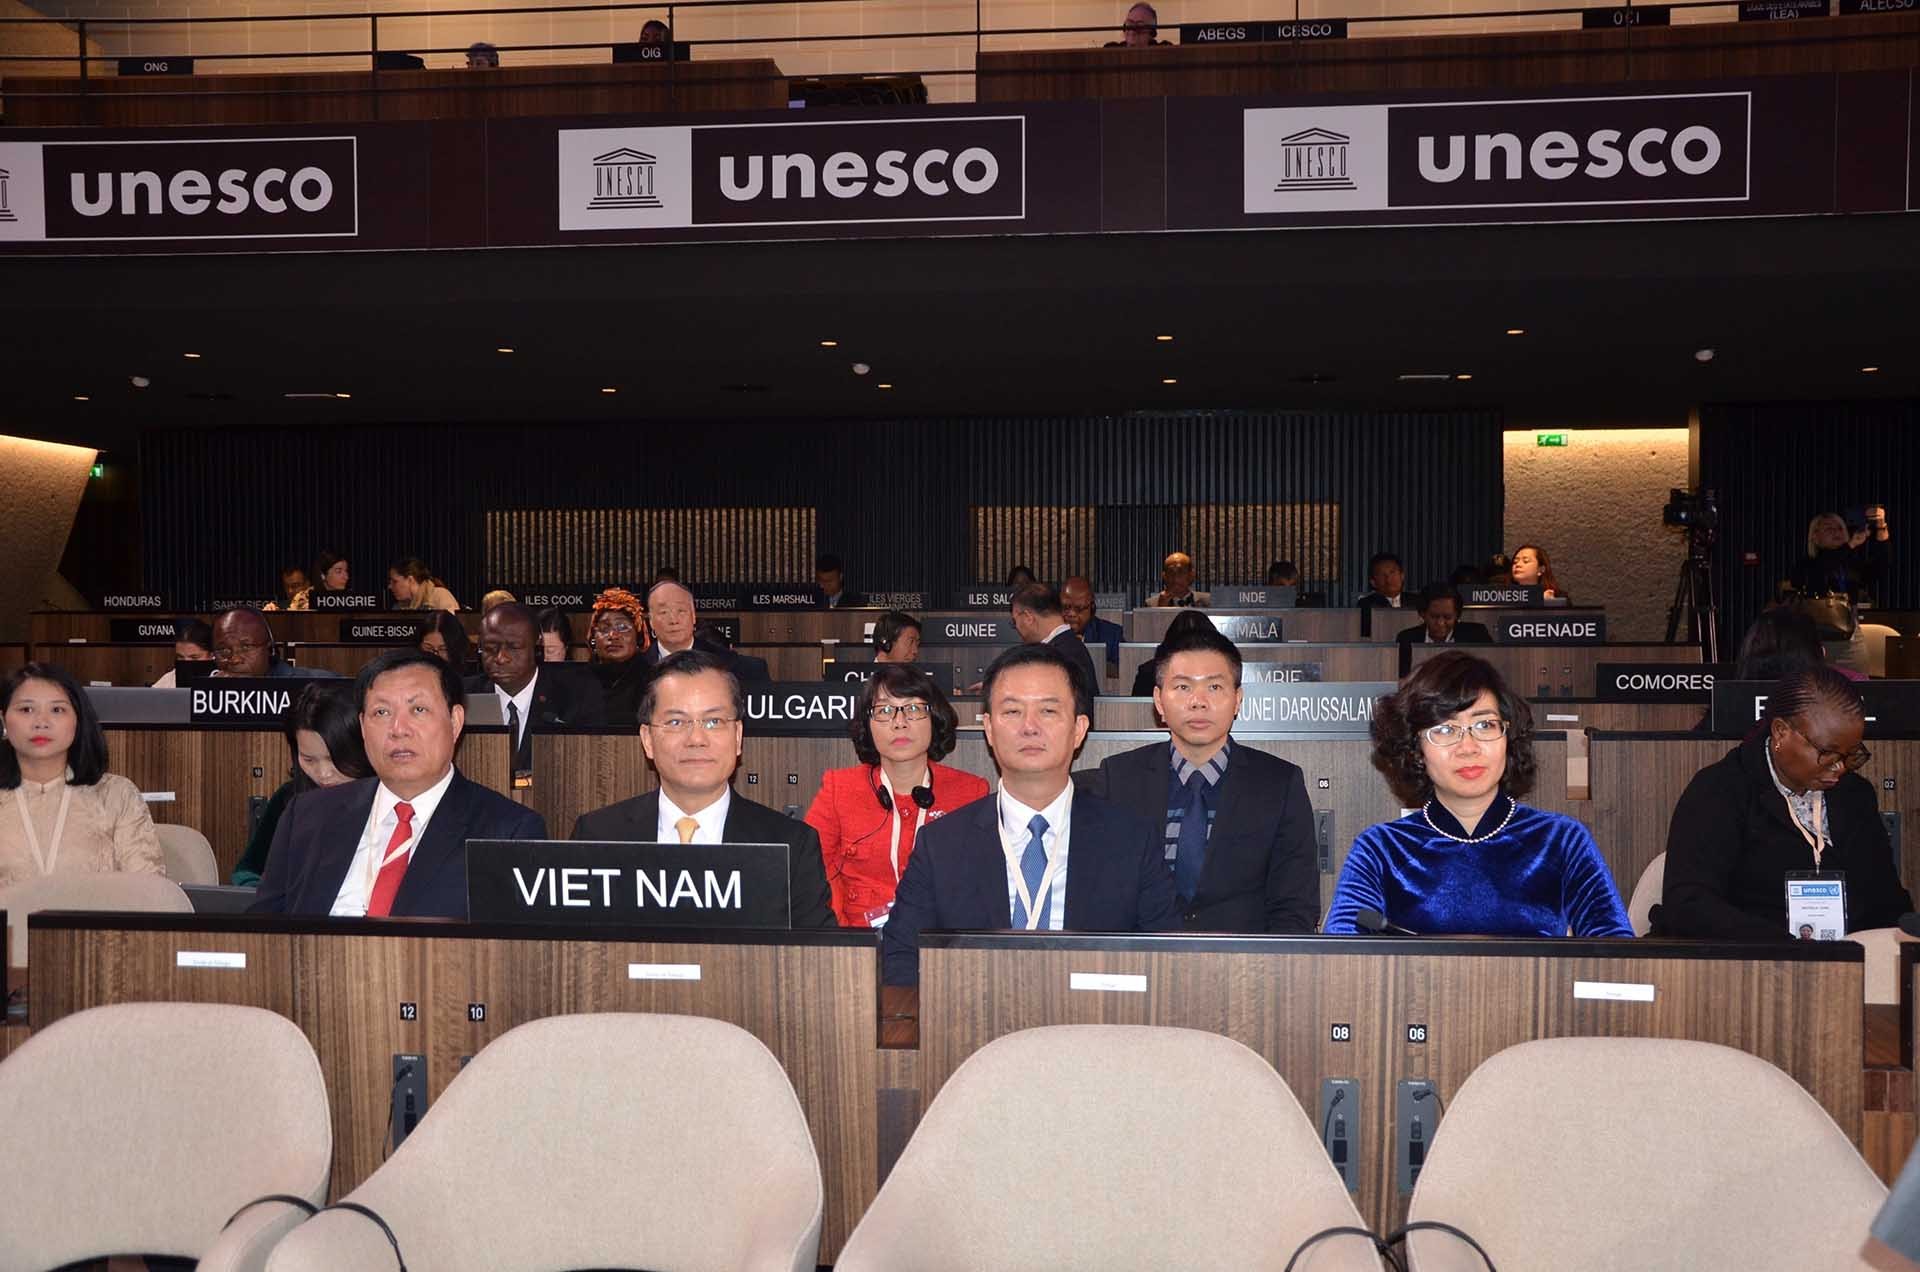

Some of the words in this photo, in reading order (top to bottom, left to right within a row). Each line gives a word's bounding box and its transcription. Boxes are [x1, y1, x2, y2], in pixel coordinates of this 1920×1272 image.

[1197, 27, 1247, 41] ABEGS
[1277, 24, 1332, 38] ICESCO
[641, 47, 661, 59] OIG
[143, 61, 168, 73] ONG
[1418, 125, 1722, 184] unesco
[1285, 146, 1346, 178] UNESCO
[719, 146, 1000, 201] unesco
[596, 165, 654, 197] UNESCO
[70, 166, 334, 217] unesco
[103, 595, 161, 607] HONDURAS
[316, 595, 376, 607] HONGRIE
[524, 595, 549, 606] ILES
[550, 594, 583, 606] COOK
[752, 594, 771, 605] ILES
[772, 594, 816, 605] MARSHALL
[968, 593, 989, 605] ILES
[1239, 591, 1266, 603] INDE
[1472, 590, 1529, 602] INDONESIE
[694, 599, 737, 609] TSERRAT
[138, 625, 175, 636] GUYANA
[352, 625, 417, 637] GUINEE-BISSA
[944, 623, 997, 638] GUINEE
[1508, 622, 1597, 638] GRENADE
[1257, 670, 1303, 683] MBIE
[1615, 673, 1715, 691] COMORES
[192, 690, 291, 715] BURKINA
[747, 694, 856, 720] ULGARI
[1237, 696, 1276, 721] UNEI
[750, 775, 757, 783] 12
[789, 775, 797, 783] 10
[1884, 780, 1895, 789] 02
[512, 867, 622, 908] VIET
[636, 869, 742, 909] NAM
[402, 1006, 415, 1018] 12
[470, 1007, 483, 1020] 10
[1333, 1027, 1349, 1040] 08
[1409, 1028, 1425, 1040] 06
